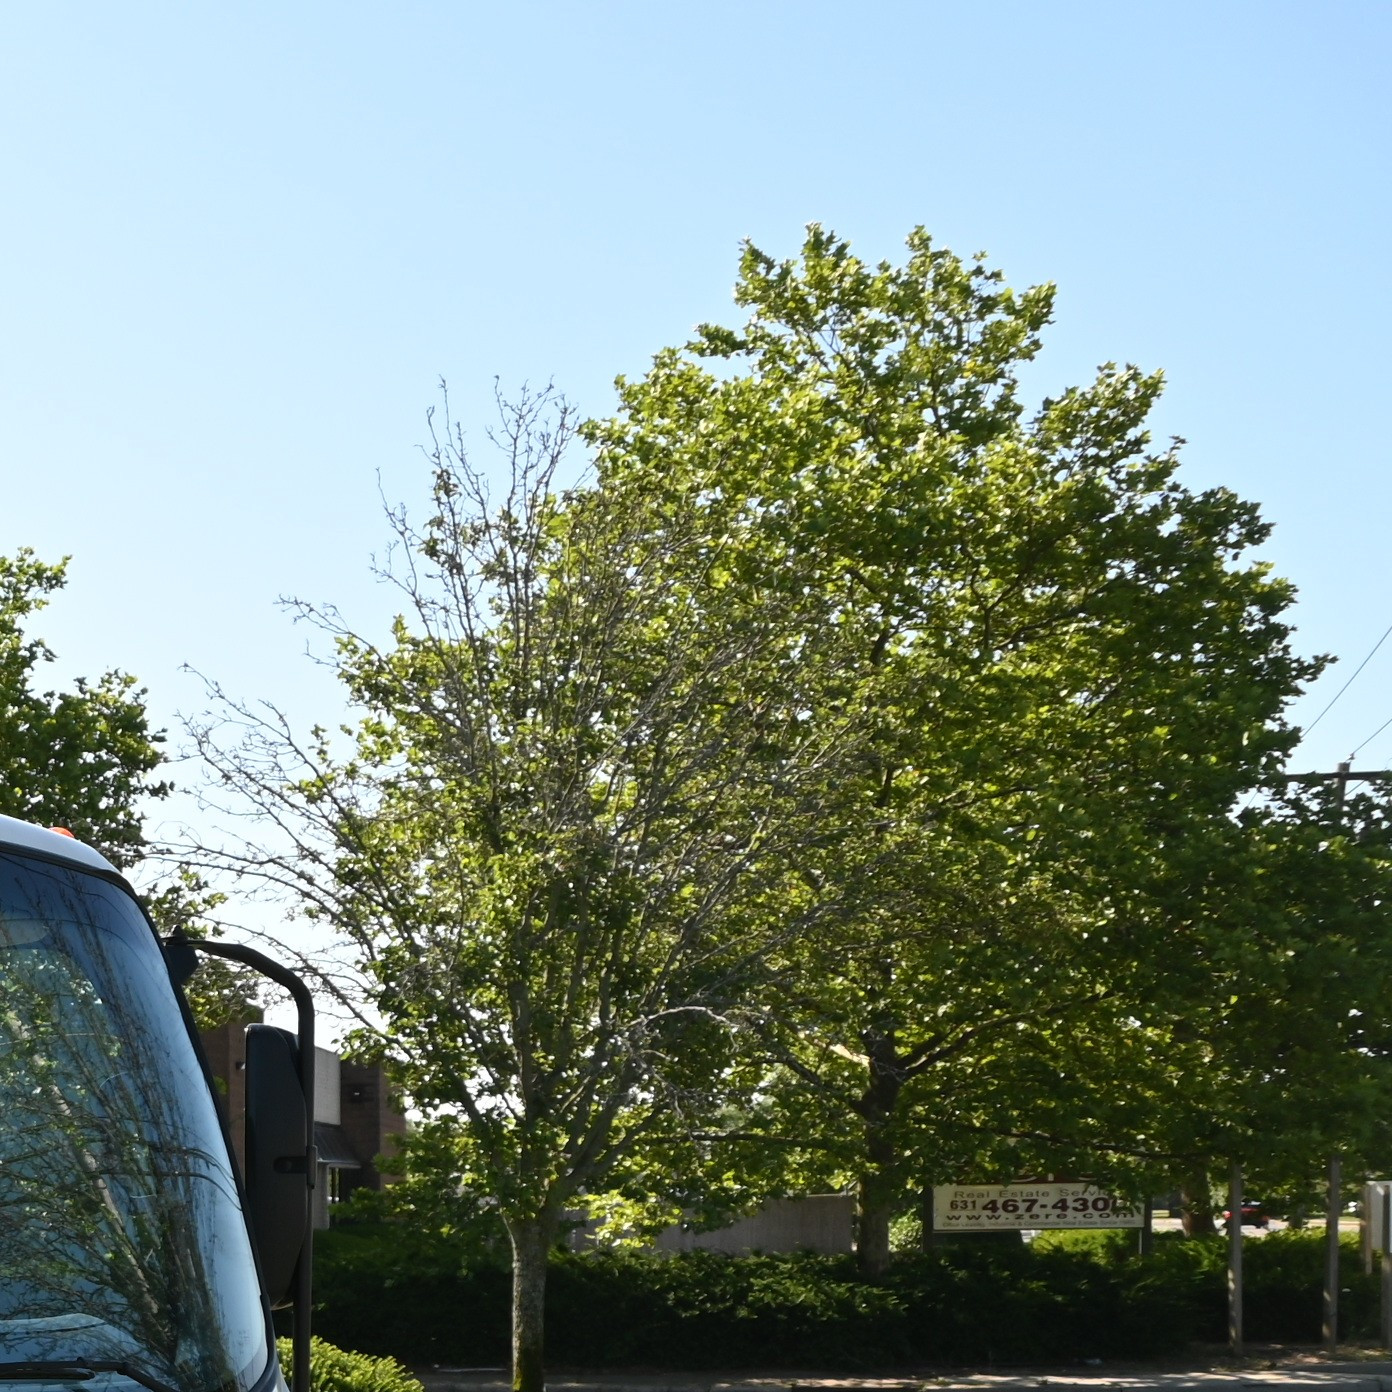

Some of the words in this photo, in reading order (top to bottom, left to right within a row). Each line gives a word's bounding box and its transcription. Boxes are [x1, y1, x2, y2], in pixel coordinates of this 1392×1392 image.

[954, 1190, 990, 1199] Real
[999, 1189, 1050, 1198] Estate
[949, 1200, 977, 1210] 631
[982, 1197, 1121, 1214] 467-430
